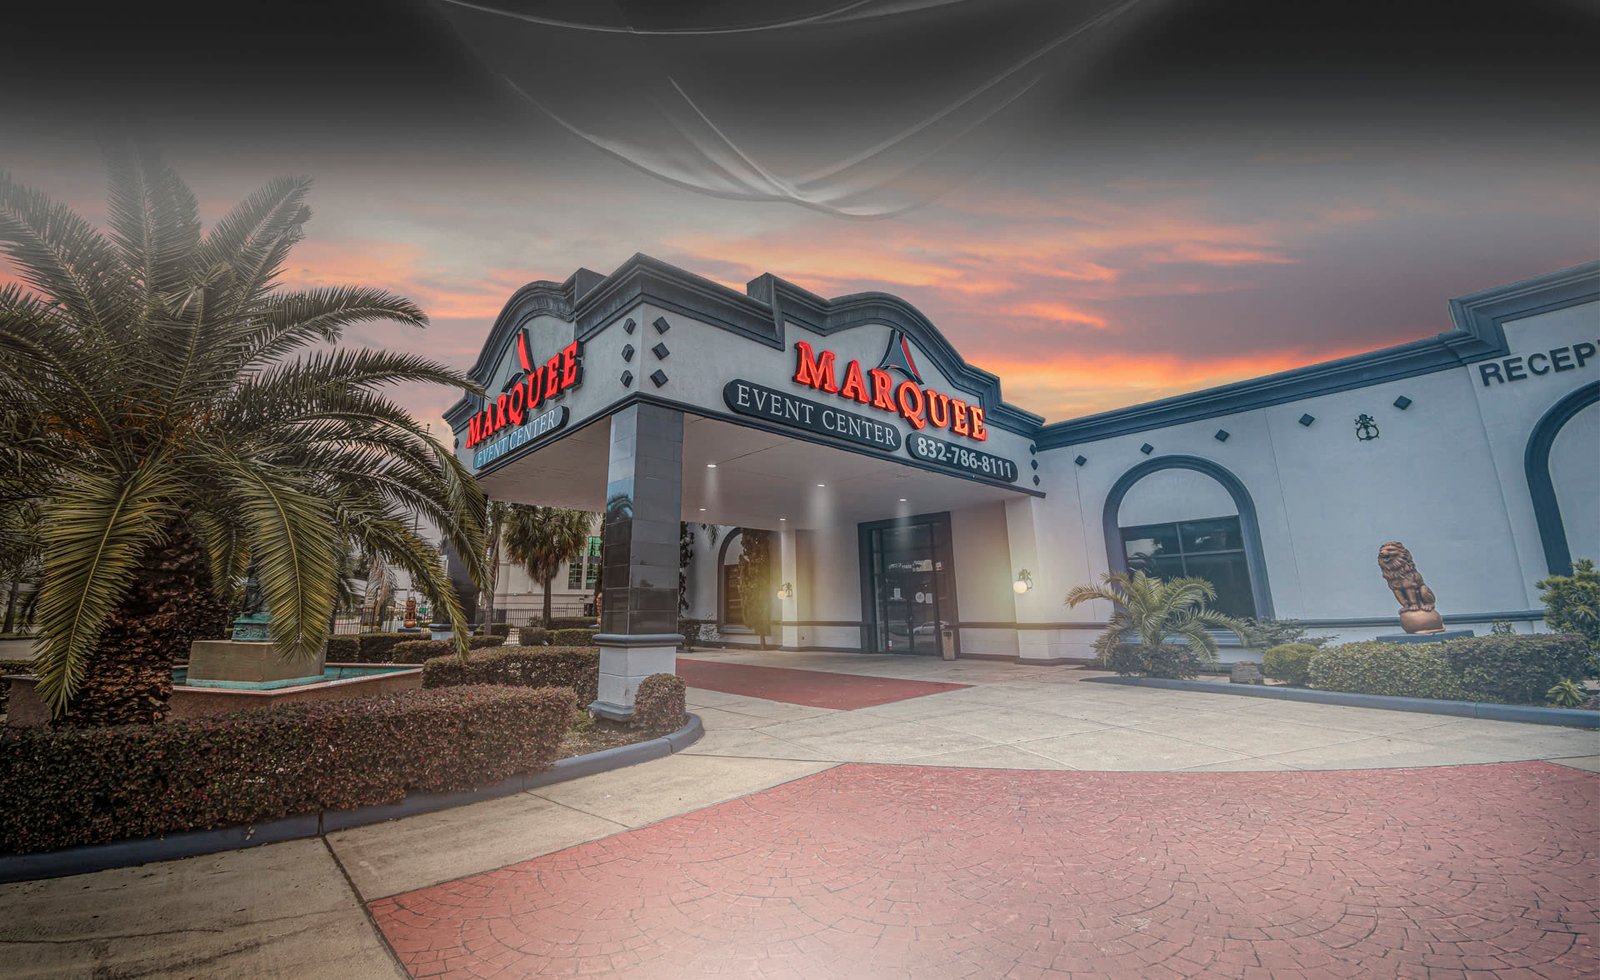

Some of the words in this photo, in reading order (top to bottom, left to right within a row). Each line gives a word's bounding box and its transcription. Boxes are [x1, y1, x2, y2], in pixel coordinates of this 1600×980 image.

[793, 341, 988, 441] MARQUEE
[1478, 339, 1600, 387] RECEP
[465, 340, 579, 449] MARQUEE
[736, 383, 814, 425] EVENT
[821, 410, 897, 447] CENTER
[476, 440, 508, 467] EVENT
[509, 409, 556, 450] CENTER
[917, 437, 1012, 479] 832-786-8111
